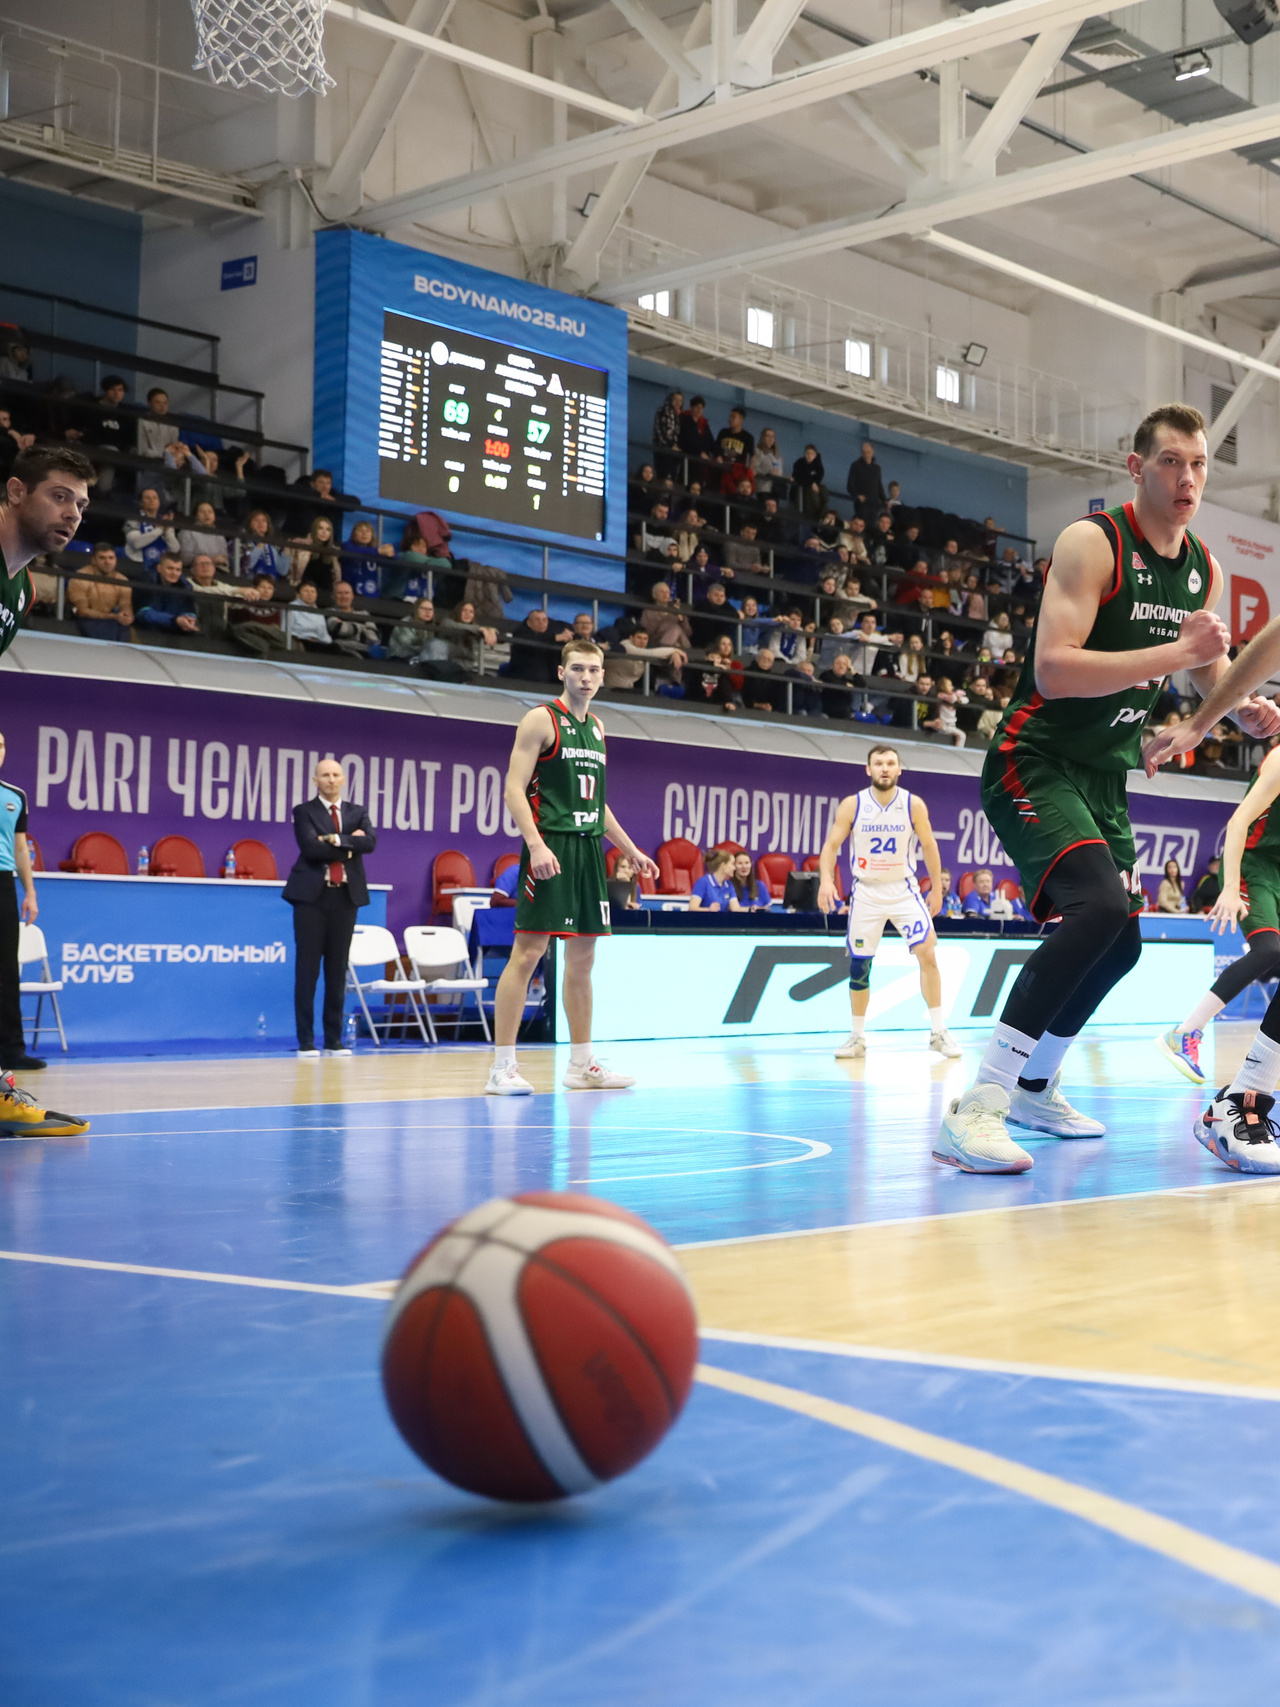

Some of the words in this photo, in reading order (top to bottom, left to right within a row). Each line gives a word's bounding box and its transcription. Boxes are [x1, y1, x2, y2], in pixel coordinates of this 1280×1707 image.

[414, 275, 586, 338] BCDYNAMO25.RU
[443, 399, 470, 425] 69
[526, 419, 551, 444] 57
[484, 438, 511, 459] 1:00
[36, 725, 151, 814] PARI
[861, 824, 906, 833] ДИНАМО
[870, 837, 897, 855] 24
[902, 920, 924, 940] 24
[61, 941, 287, 964] БАСКЕТБОЛЬНЫЙ
[61, 965, 135, 984] КЛУБ
